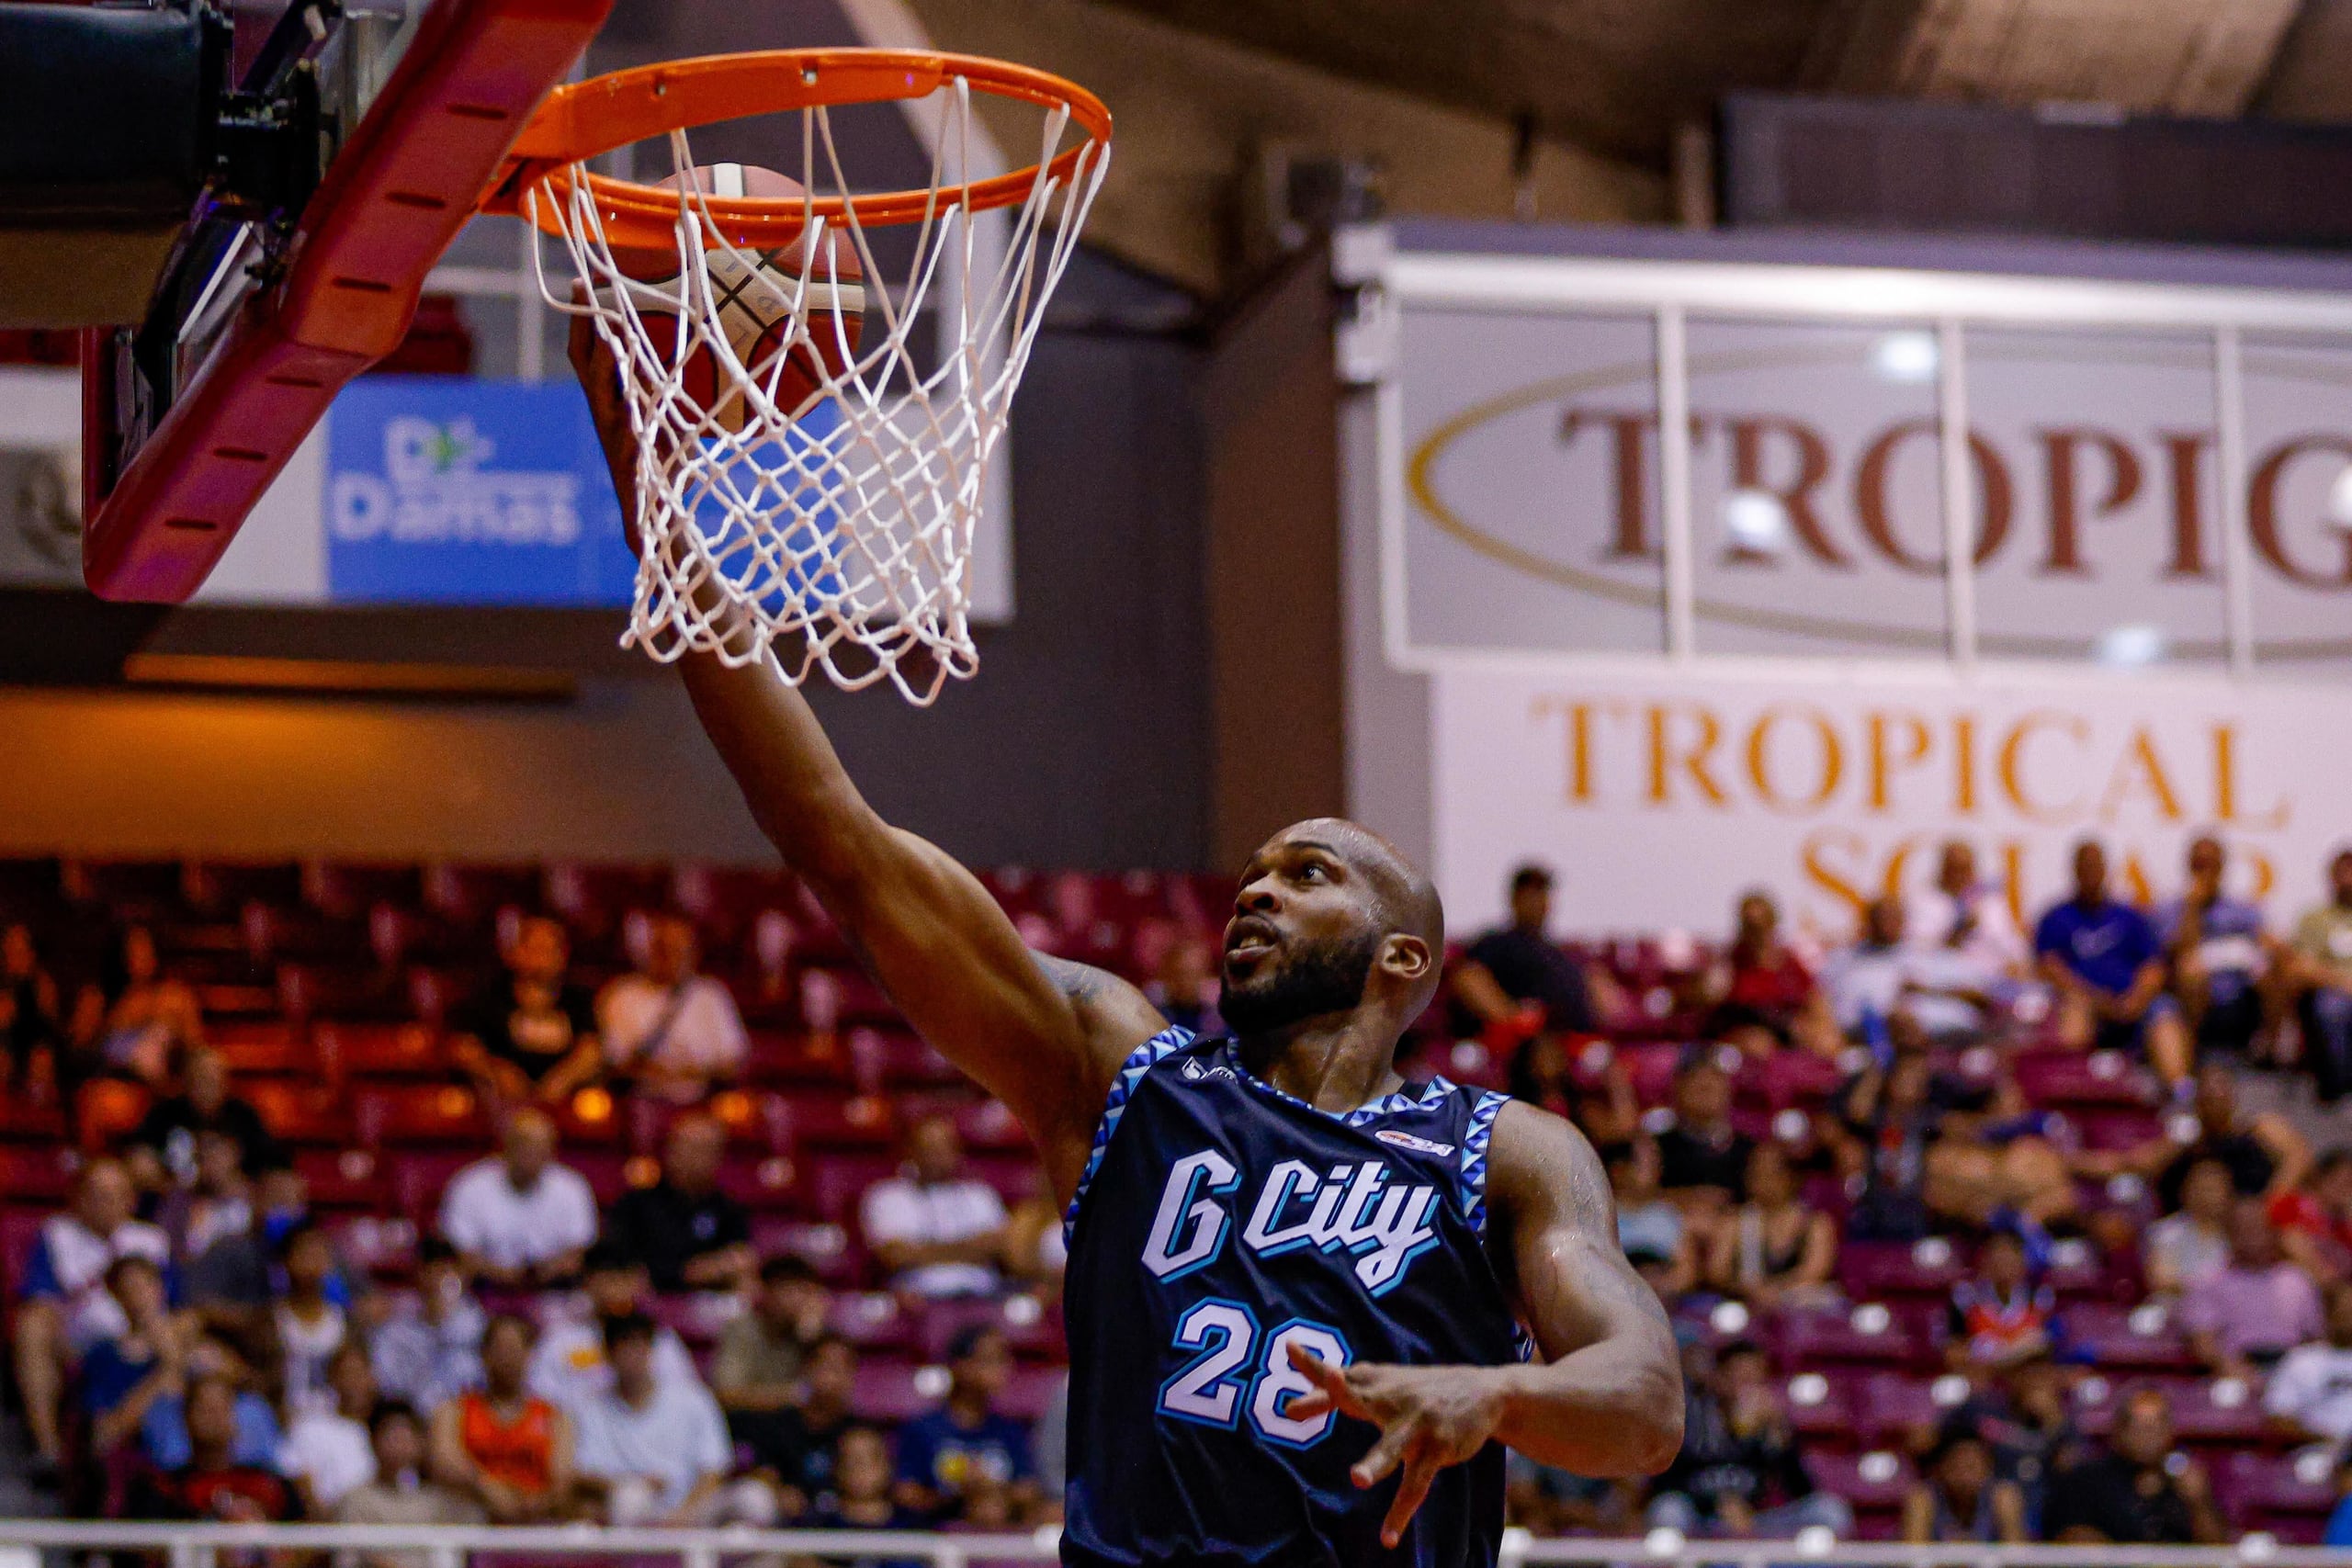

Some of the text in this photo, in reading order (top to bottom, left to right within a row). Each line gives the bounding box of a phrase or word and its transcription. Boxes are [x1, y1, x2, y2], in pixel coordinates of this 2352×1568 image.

[1527, 694, 2293, 832] TROPICAL
[1141, 1148, 1441, 1298] G City
[1155, 1296, 1353, 1451] 28
